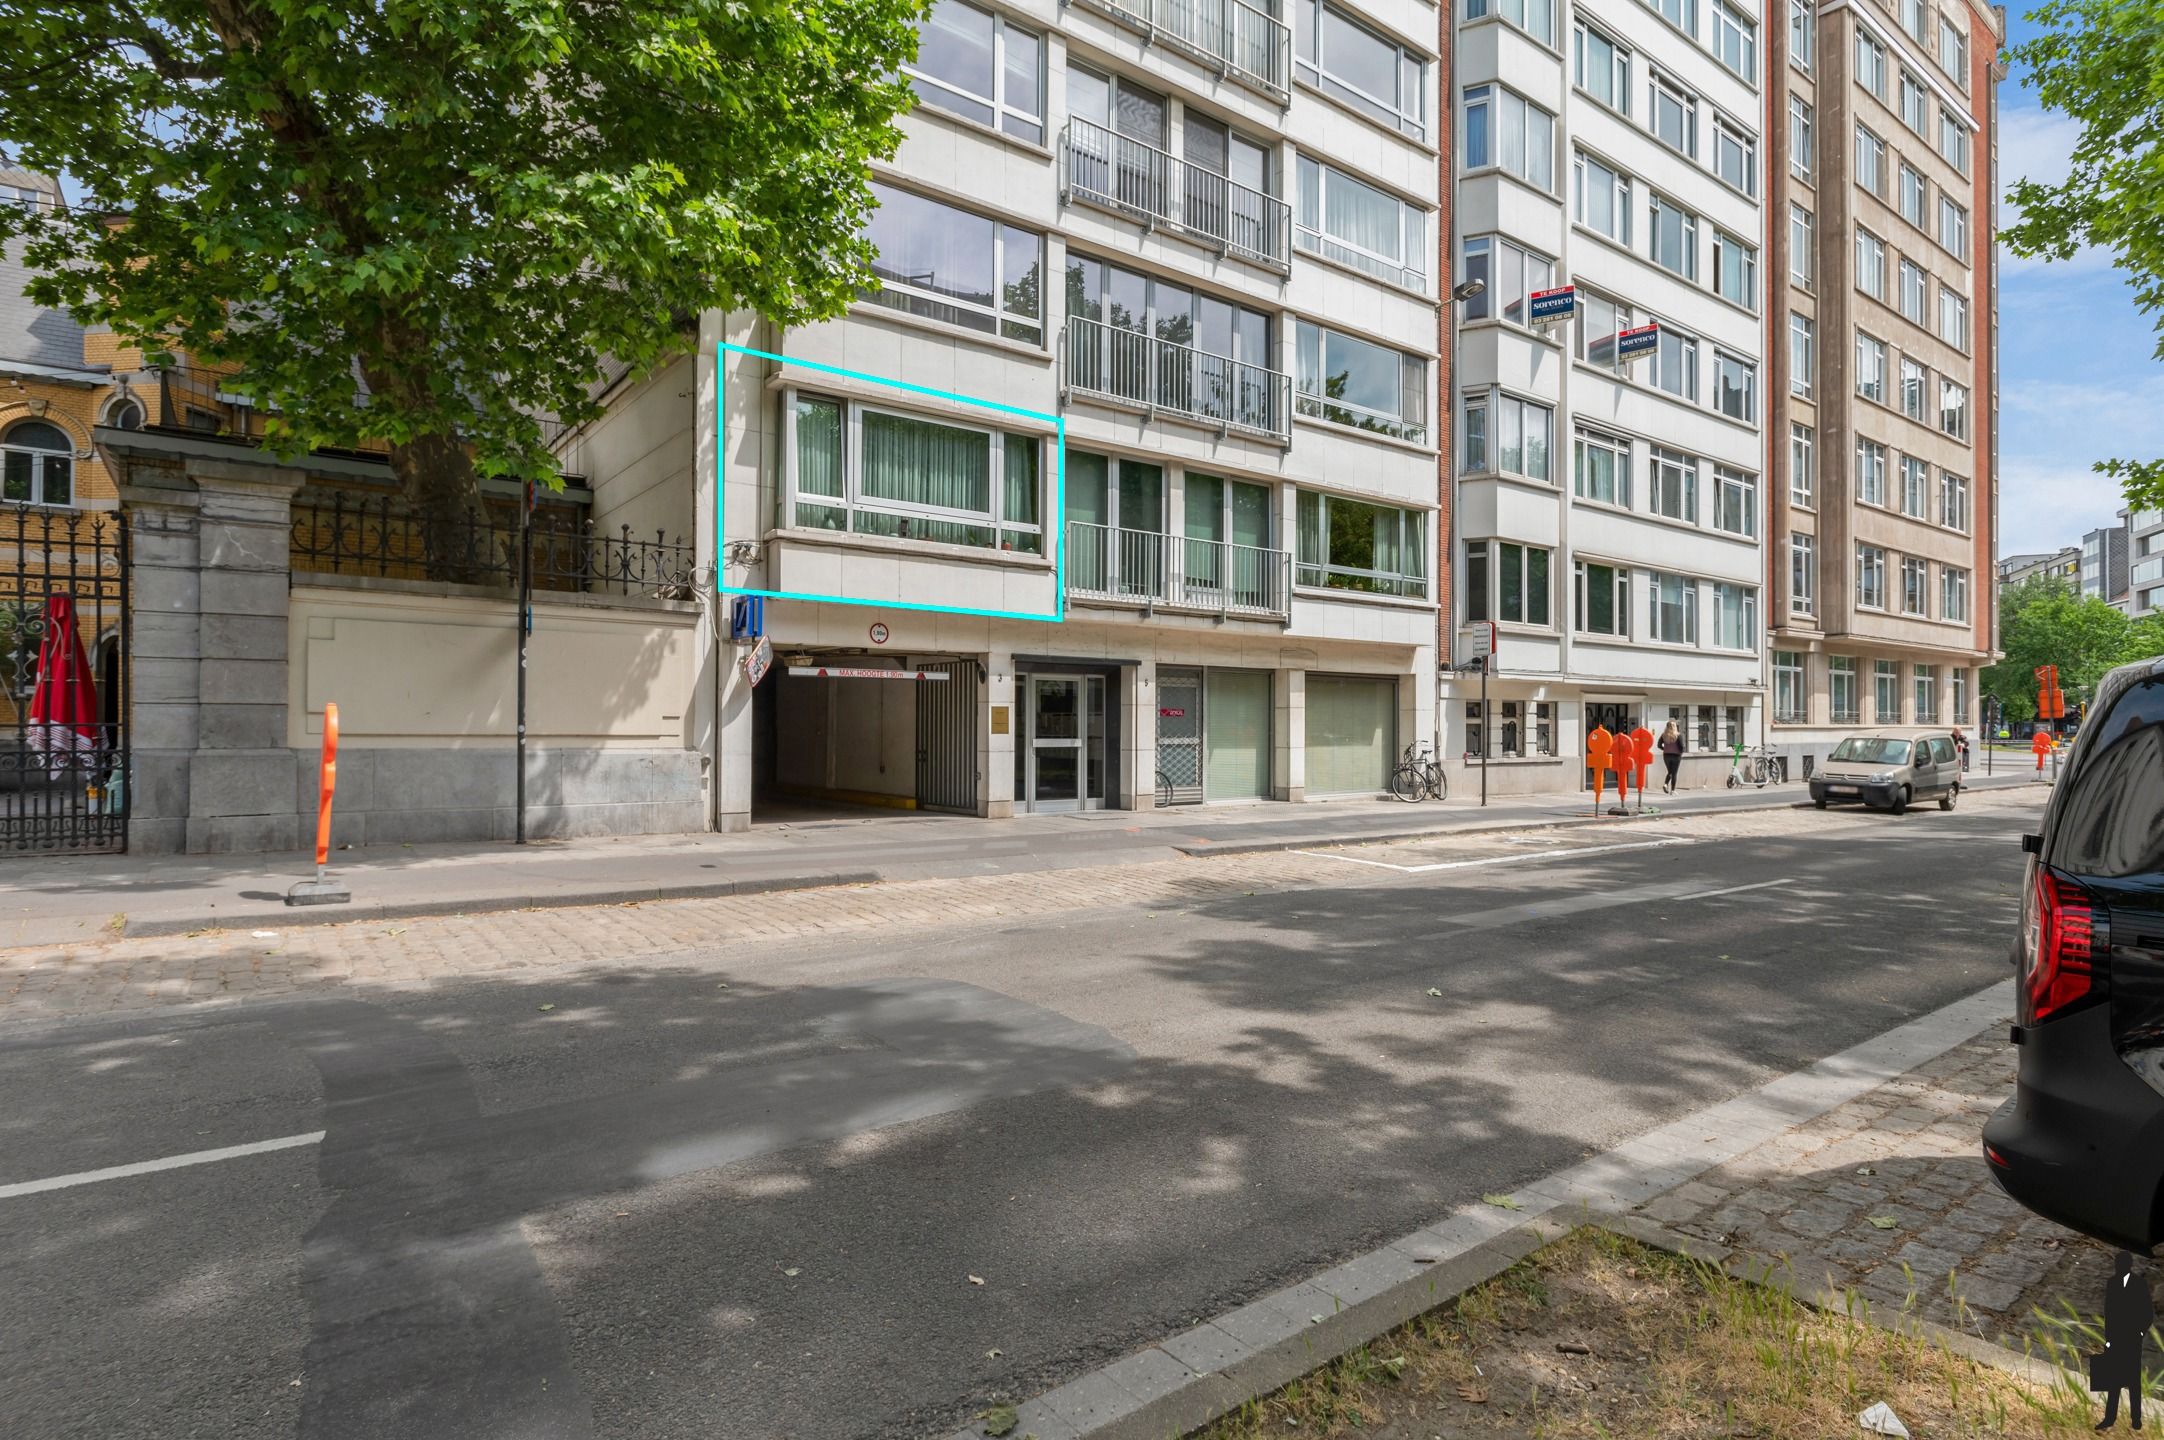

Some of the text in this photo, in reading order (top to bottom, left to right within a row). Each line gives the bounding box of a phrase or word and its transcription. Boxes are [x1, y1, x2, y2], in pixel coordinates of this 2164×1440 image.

[1533, 297, 1572, 309] sorenco
[1621, 335, 1655, 346] sorenco
[857, 669, 885, 677] HOOGTE
[997, 673, 1003, 683] 3
[1144, 678, 1149, 688] 5
